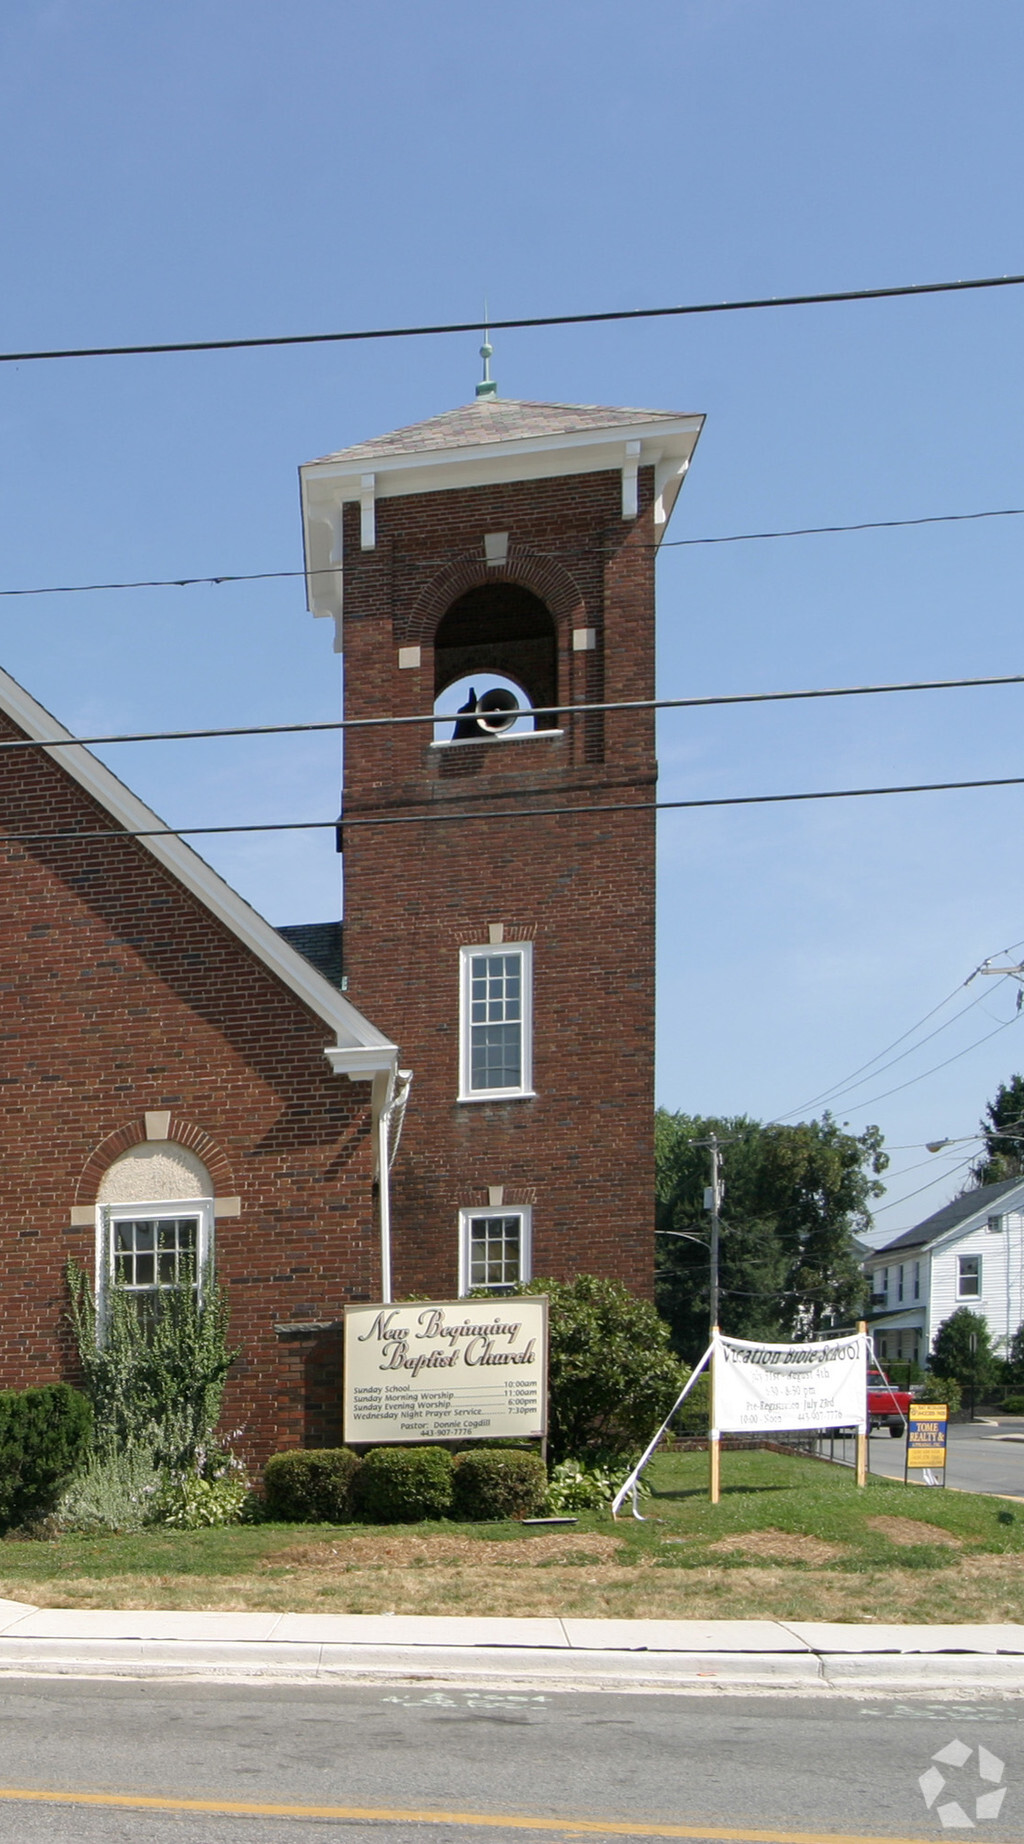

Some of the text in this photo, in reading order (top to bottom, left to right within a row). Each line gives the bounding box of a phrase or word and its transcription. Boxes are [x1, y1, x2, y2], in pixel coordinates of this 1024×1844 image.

[357, 1308, 522, 1347] New Beginning
[379, 1336, 536, 1378] Baptist Church
[783, 1346, 818, 1364] Bible
[818, 1340, 860, 1363] School
[353, 1380, 537, 1395] Sunday School 10:00am
[803, 1386, 816, 1398] pm
[353, 1389, 537, 1403] Sunday Morning Worship 11:00am
[353, 1398, 537, 1412] Sunday Evening Worship 6:00pm
[803, 1398, 818, 1413] July
[819, 1397, 835, 1409] 23rd
[353, 1407, 537, 1420] Wednesday Night Prayer Service 7:30pm
[400, 1419, 491, 1430] Pastor: Donnie Cogdill
[916, 1422, 939, 1432] TOME
[420, 1428, 472, 1437] 443-907-7776
[909, 1432, 937, 1442] REALTY
